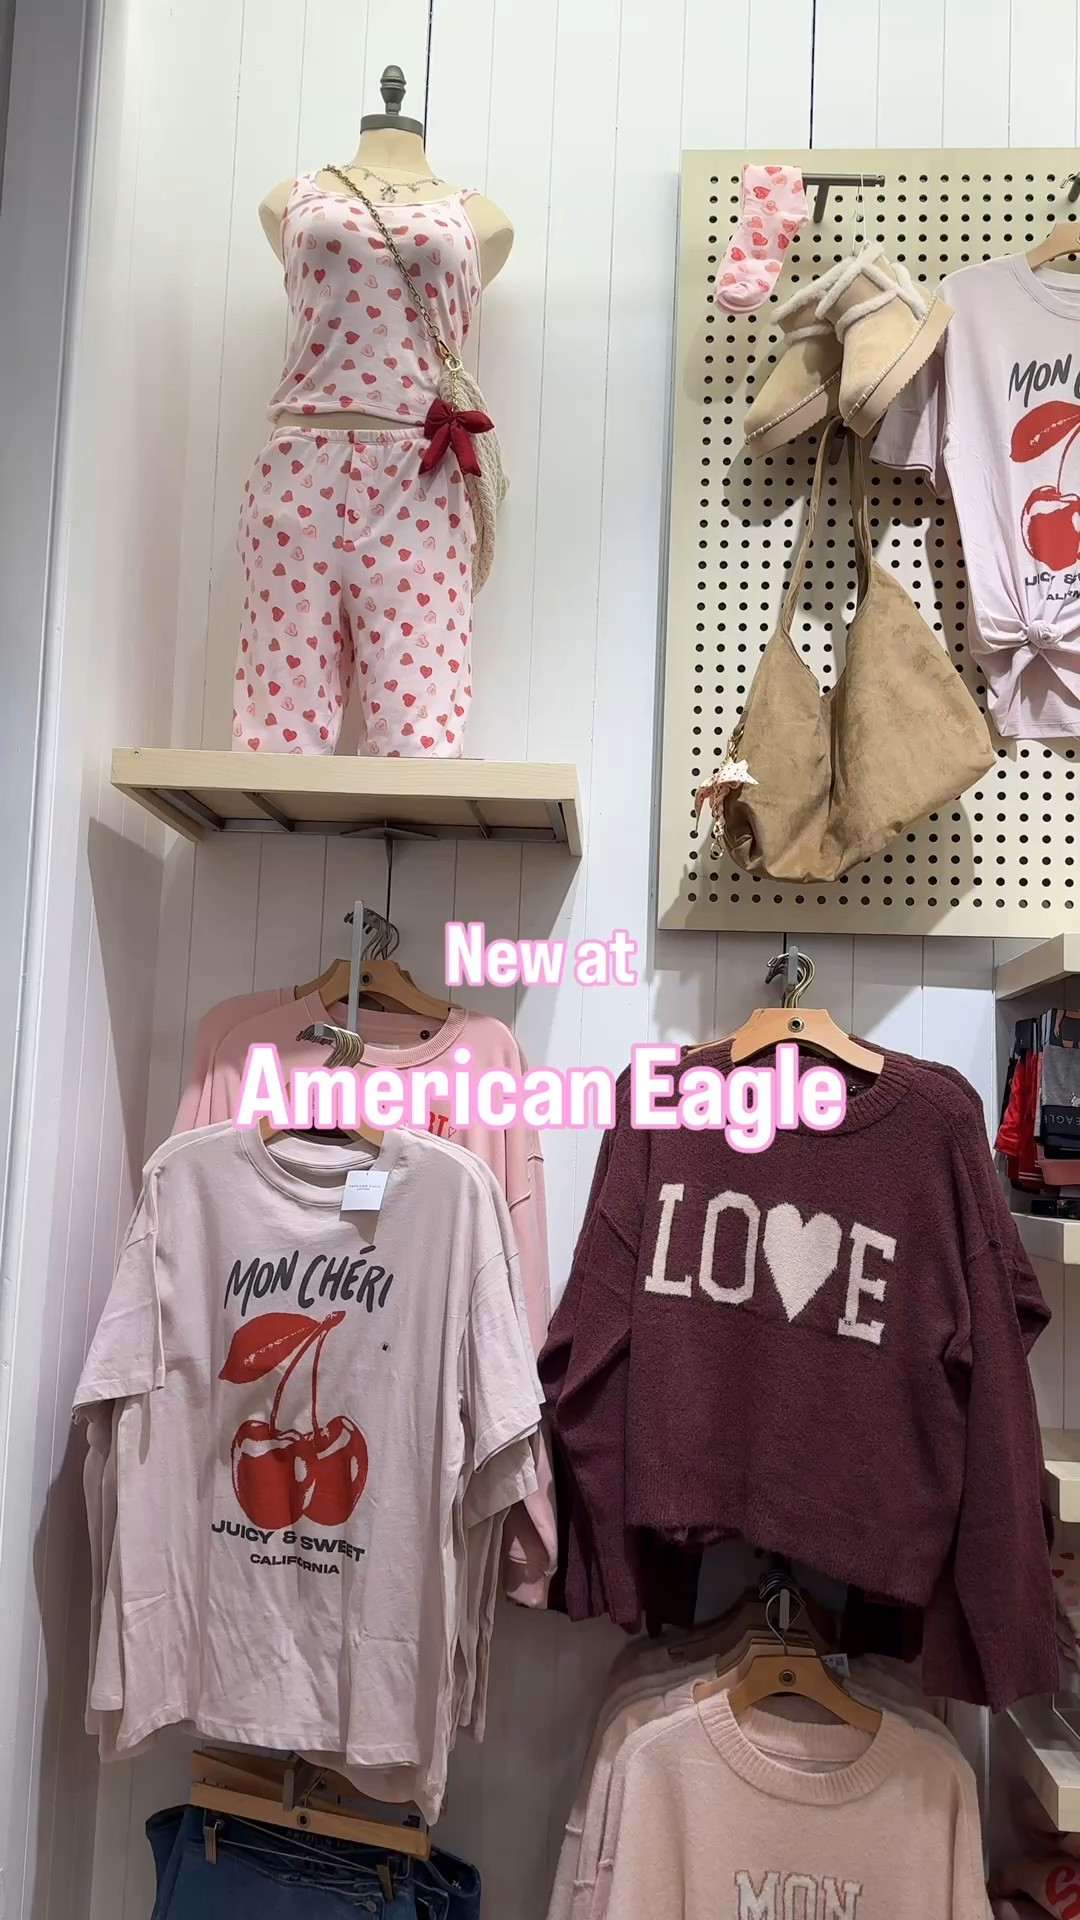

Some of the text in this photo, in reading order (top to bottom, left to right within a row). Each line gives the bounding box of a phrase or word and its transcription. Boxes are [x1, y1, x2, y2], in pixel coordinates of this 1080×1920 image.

[1008, 353, 1072, 408] MON
[1063, 573, 1077, 585] &
[224, 1245, 394, 1316] MON CHÉRI
[211, 1520, 365, 1562] JUICY & SWEET
[250, 1553, 340, 1574] CALIFORNIA
[734, 1869, 863, 1920] MON
